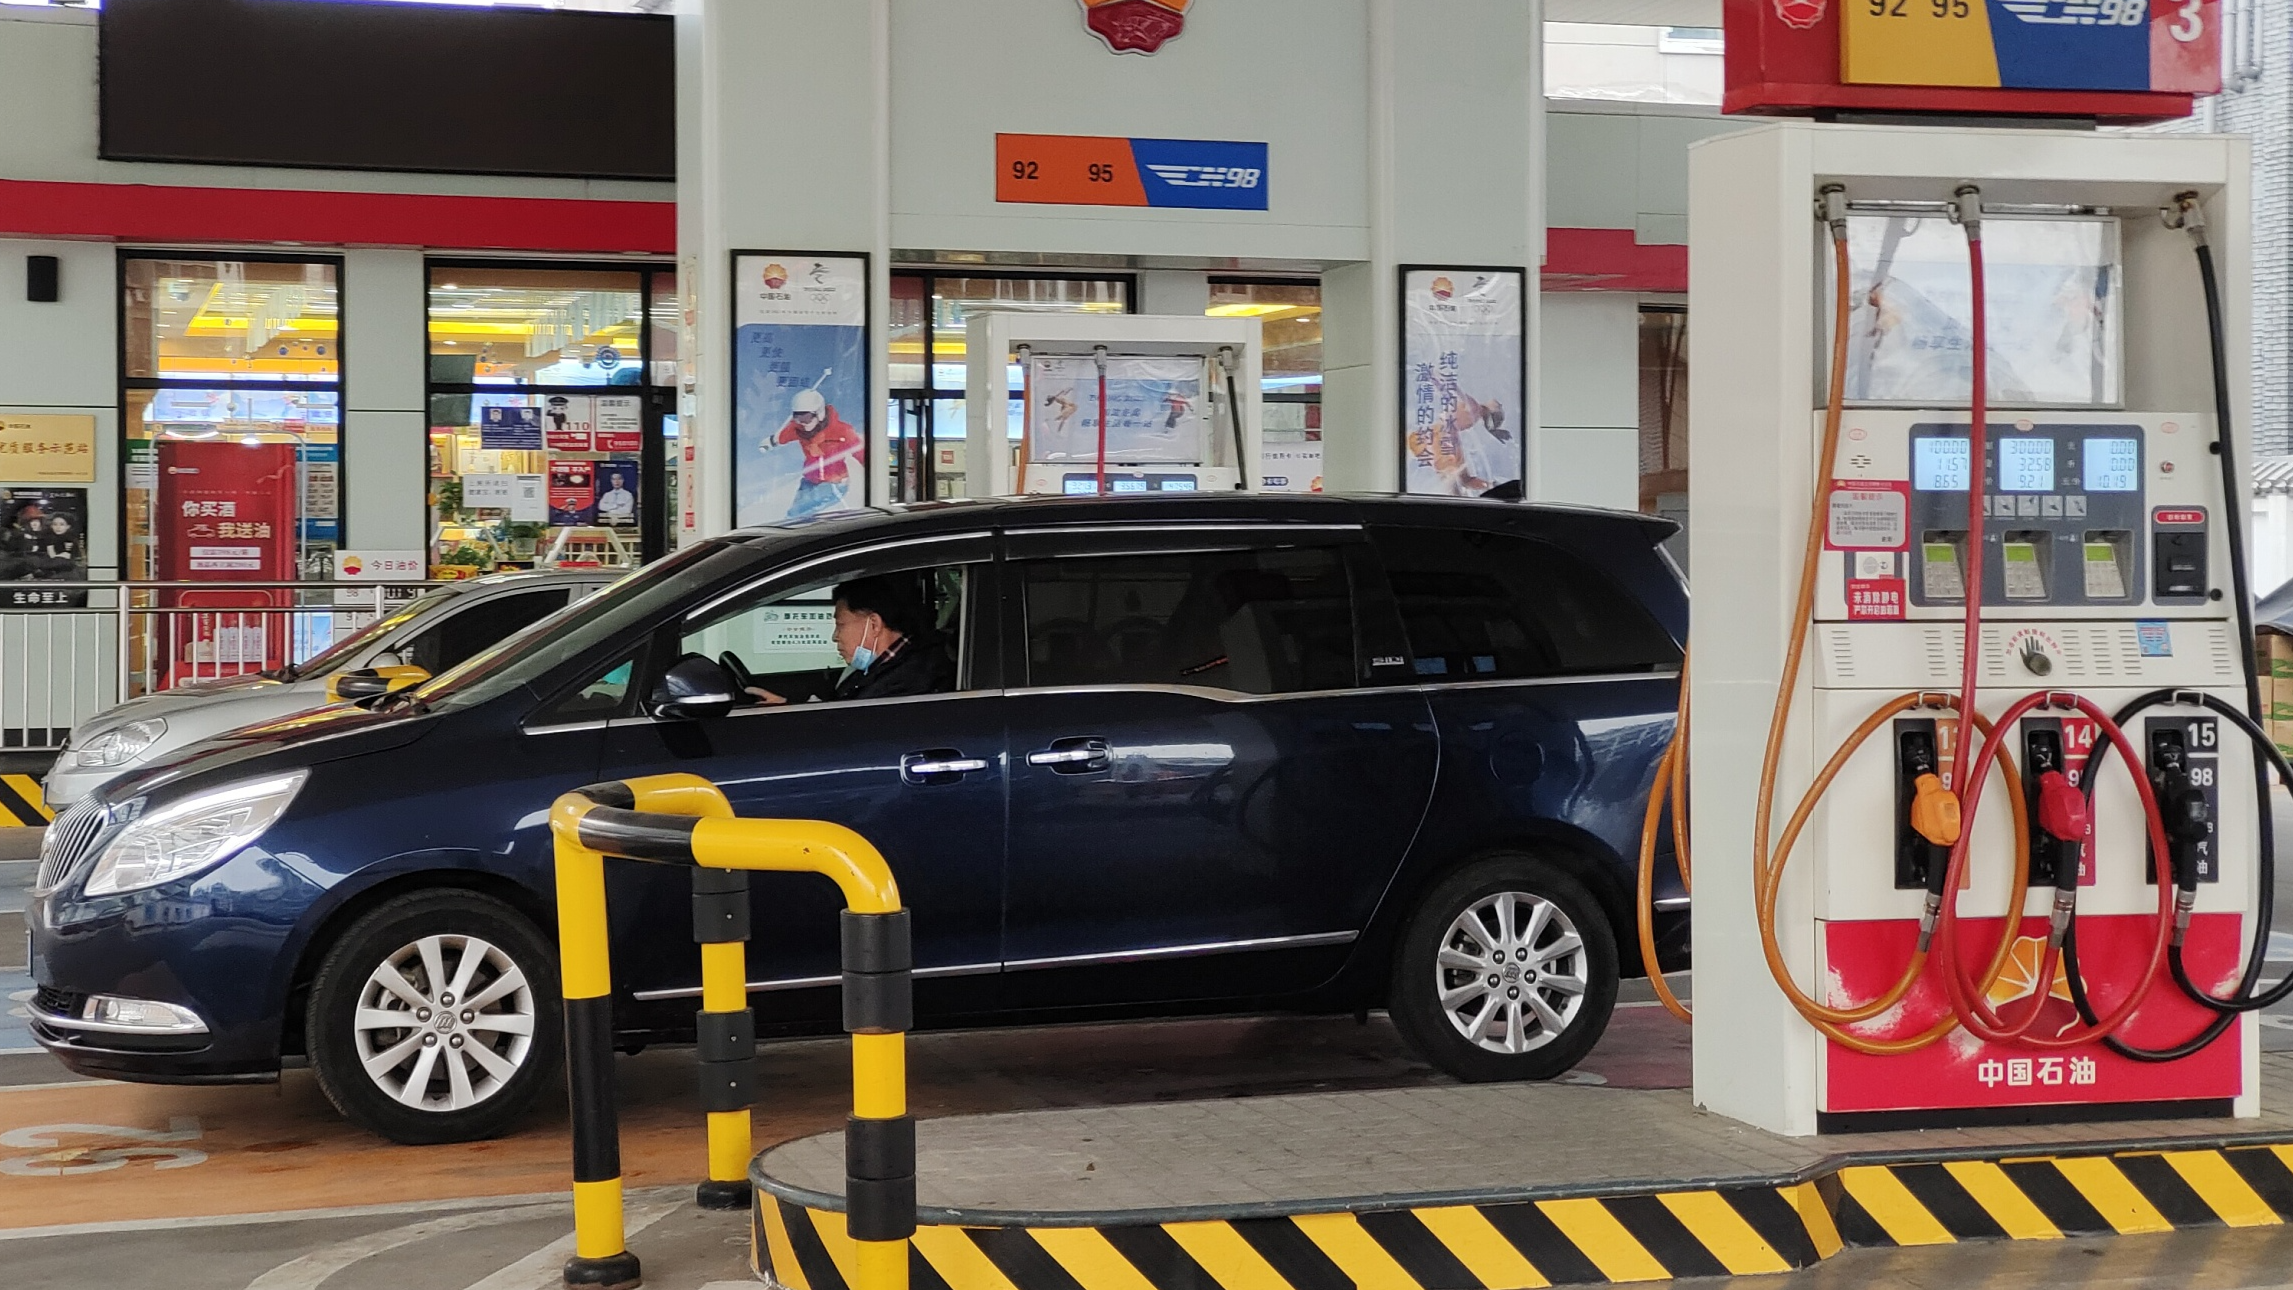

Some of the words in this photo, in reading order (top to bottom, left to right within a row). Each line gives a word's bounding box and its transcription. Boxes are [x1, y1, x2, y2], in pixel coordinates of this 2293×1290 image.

[1012, 161, 1039, 180] 92
[1088, 164, 1114, 182] 95
[1439, 350, 1459, 456] 纯洁的冰雪
[1415, 361, 1435, 469] 激情的约会
[566, 422, 590, 431] 110
[181, 500, 237, 518] 你买酒
[217, 522, 272, 539] 我送油
[370, 559, 419, 571] 今日油价
[13, 592, 69, 605] 生命至上
[2064, 724, 2093, 749] 14
[2187, 722, 2216, 747] 15
[2190, 767, 2214, 787] 98
[1978, 1056, 2096, 1088] 中国石油
